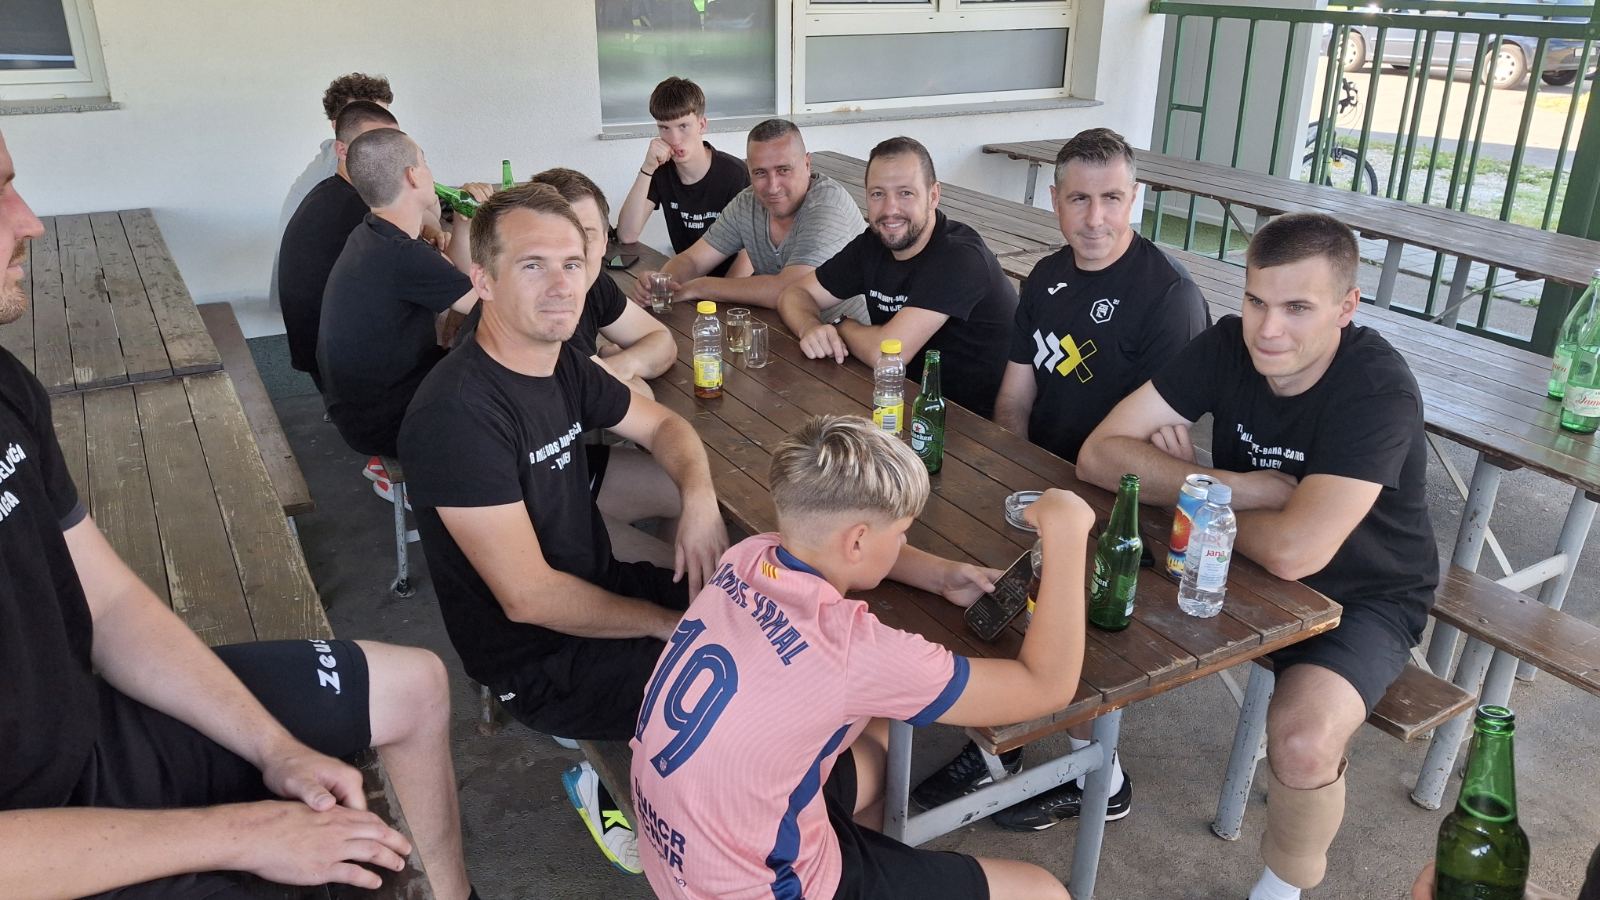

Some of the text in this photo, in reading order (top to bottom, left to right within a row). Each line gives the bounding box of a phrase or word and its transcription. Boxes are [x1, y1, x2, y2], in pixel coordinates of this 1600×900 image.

[751, 591, 810, 666] YAMAL
[308, 638, 341, 695] Zeu
[635, 618, 739, 779] 19
